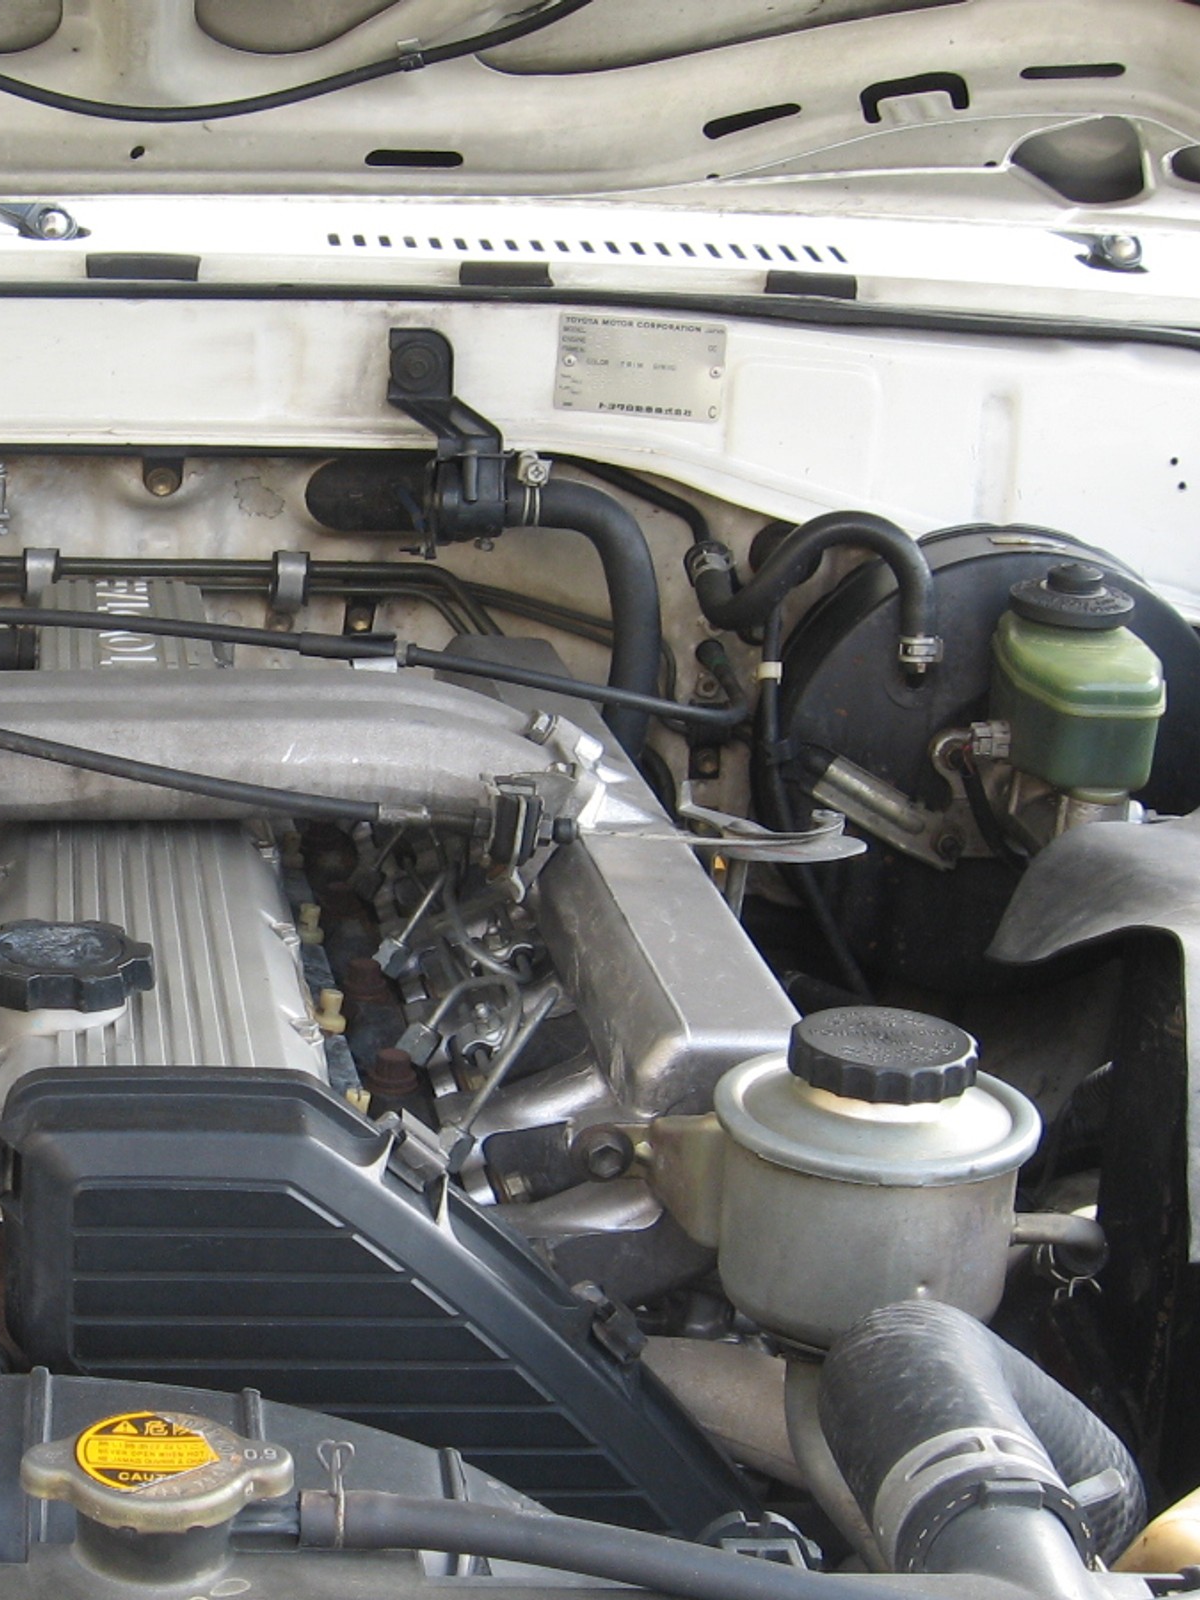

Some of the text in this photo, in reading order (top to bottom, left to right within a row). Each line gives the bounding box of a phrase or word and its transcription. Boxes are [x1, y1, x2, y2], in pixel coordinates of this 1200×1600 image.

[565, 316, 599, 326] TOYOTA
[602, 319, 634, 328] MOTOR
[636, 321, 702, 333] CORPORATION
[587, 358, 609, 366] COLOR
[244, 1447, 278, 1461] 0.9
